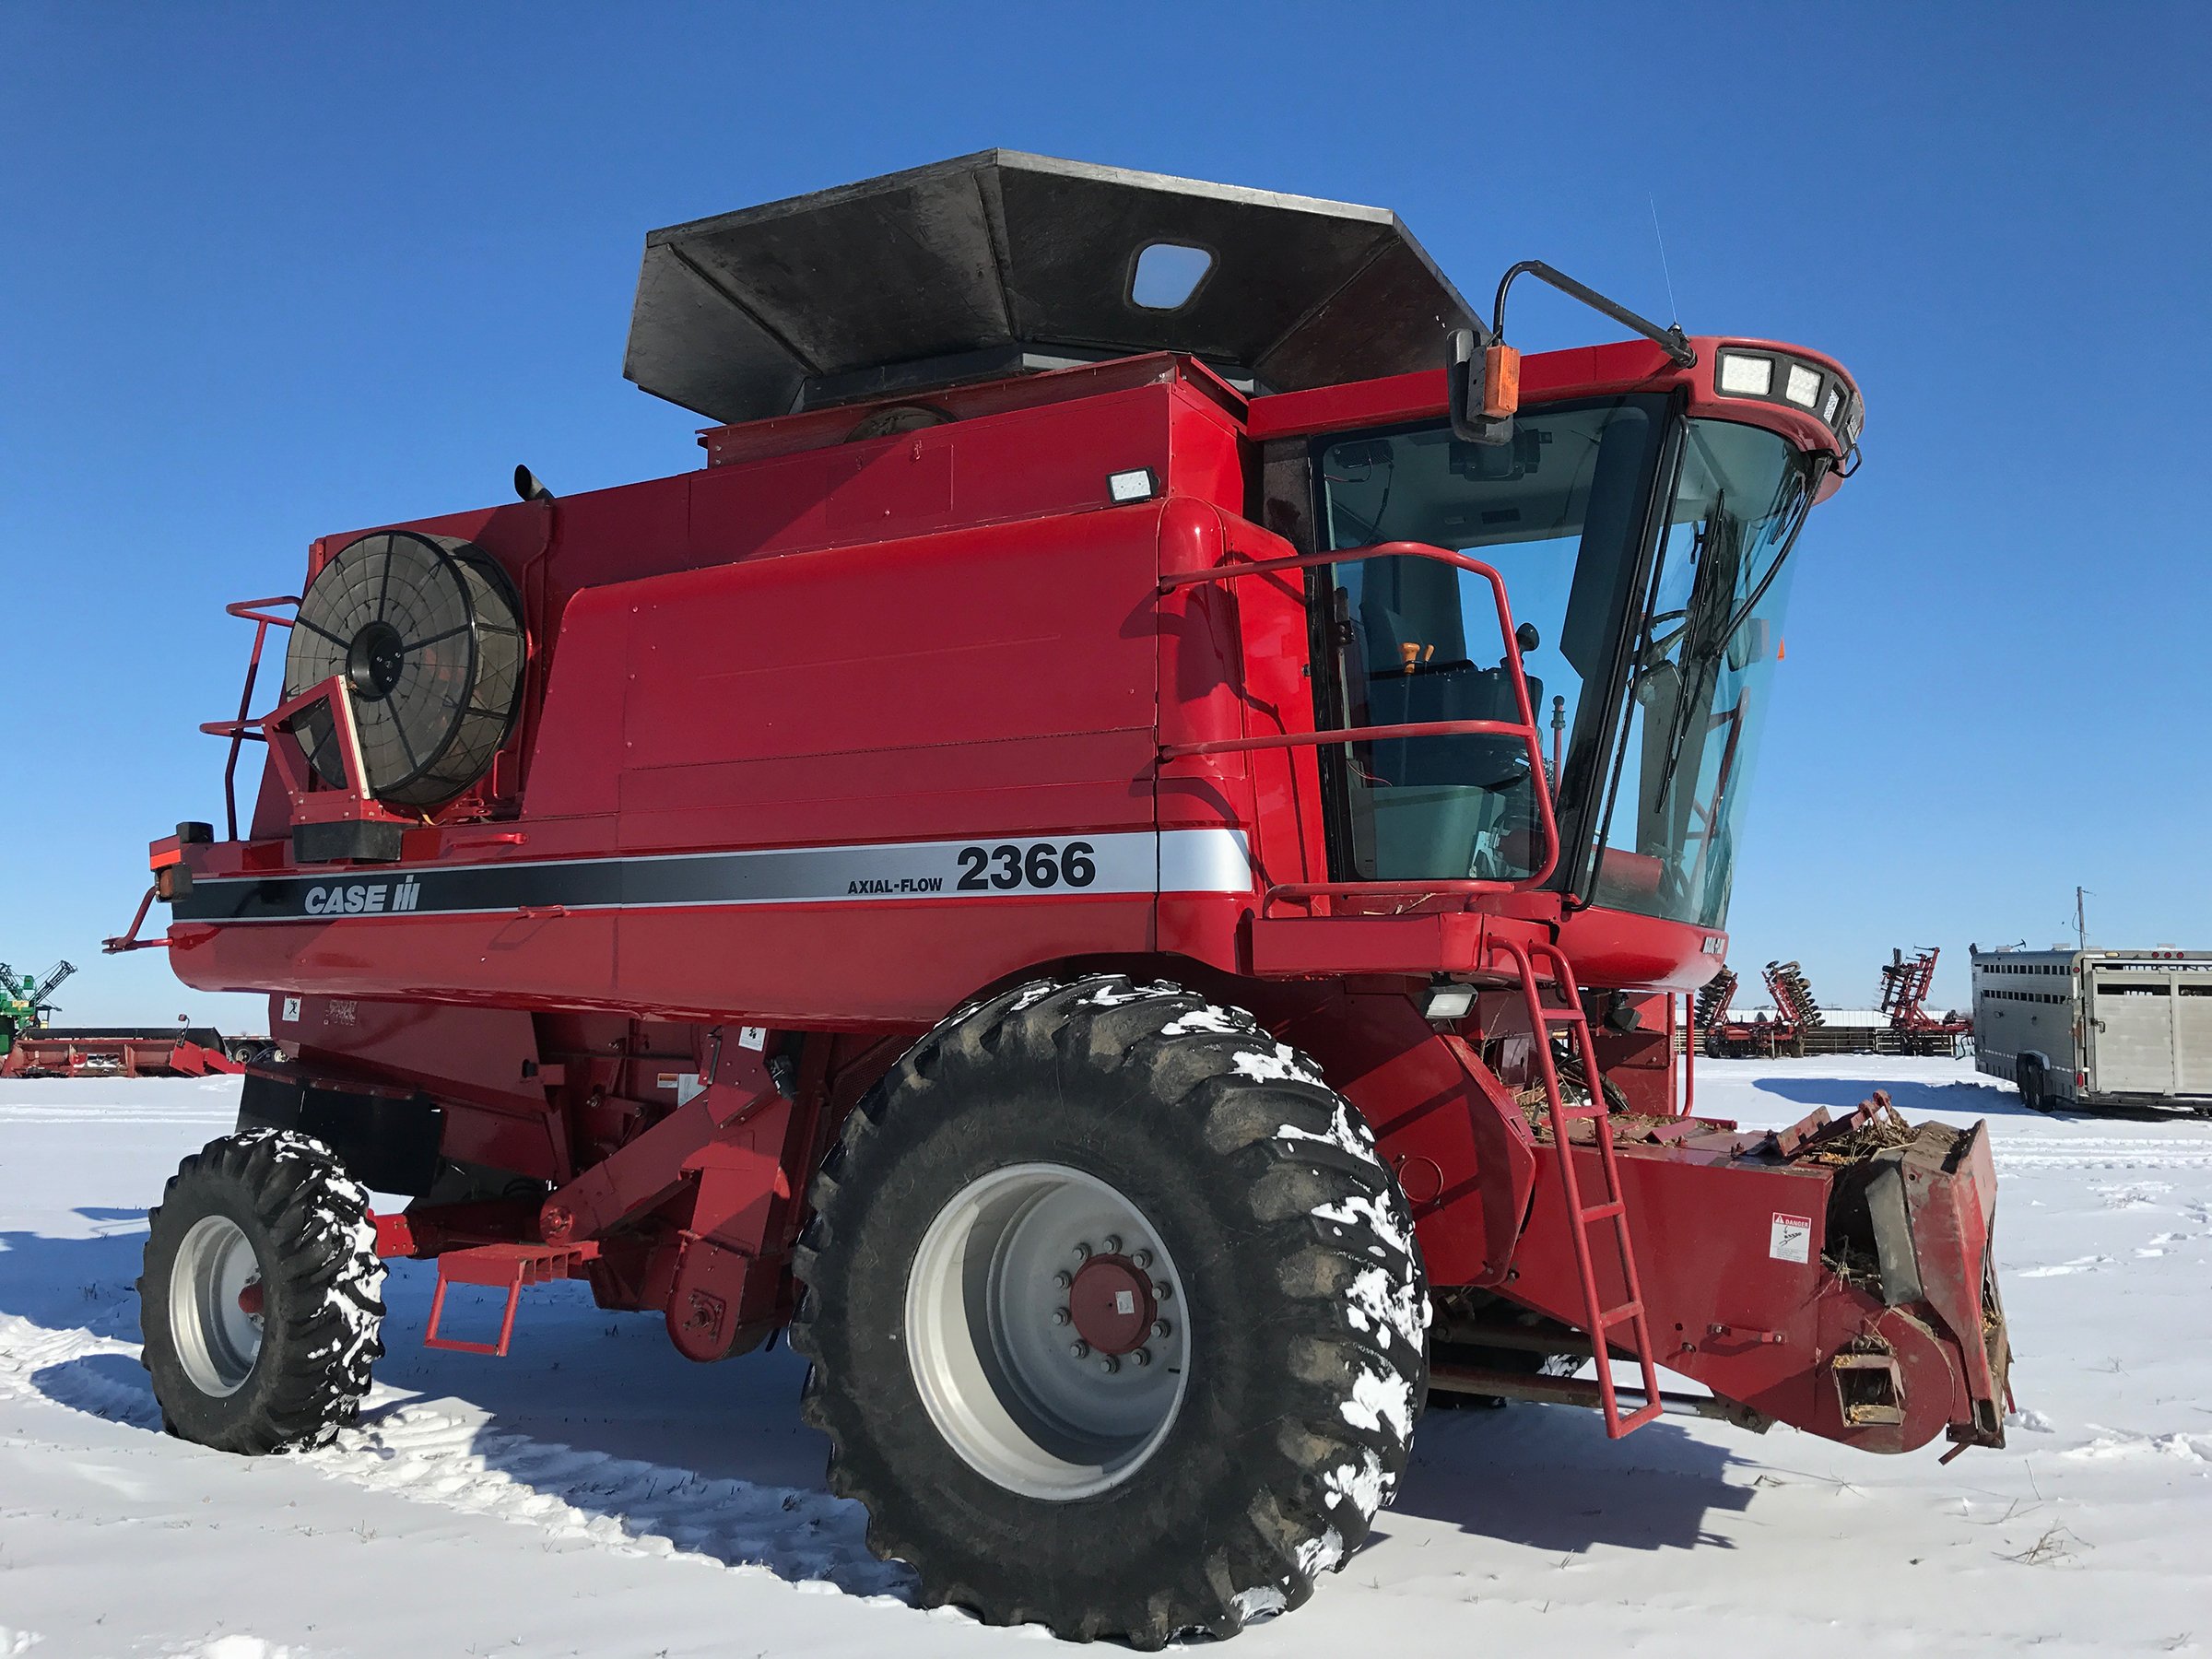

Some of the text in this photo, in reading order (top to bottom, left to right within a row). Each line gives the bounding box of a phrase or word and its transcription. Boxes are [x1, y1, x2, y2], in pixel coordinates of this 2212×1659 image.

[848, 841, 1096, 894] AXIAL-FLOW 2366
[304, 885, 387, 914] CASE
[1784, 1219, 1808, 1228] DANGER
